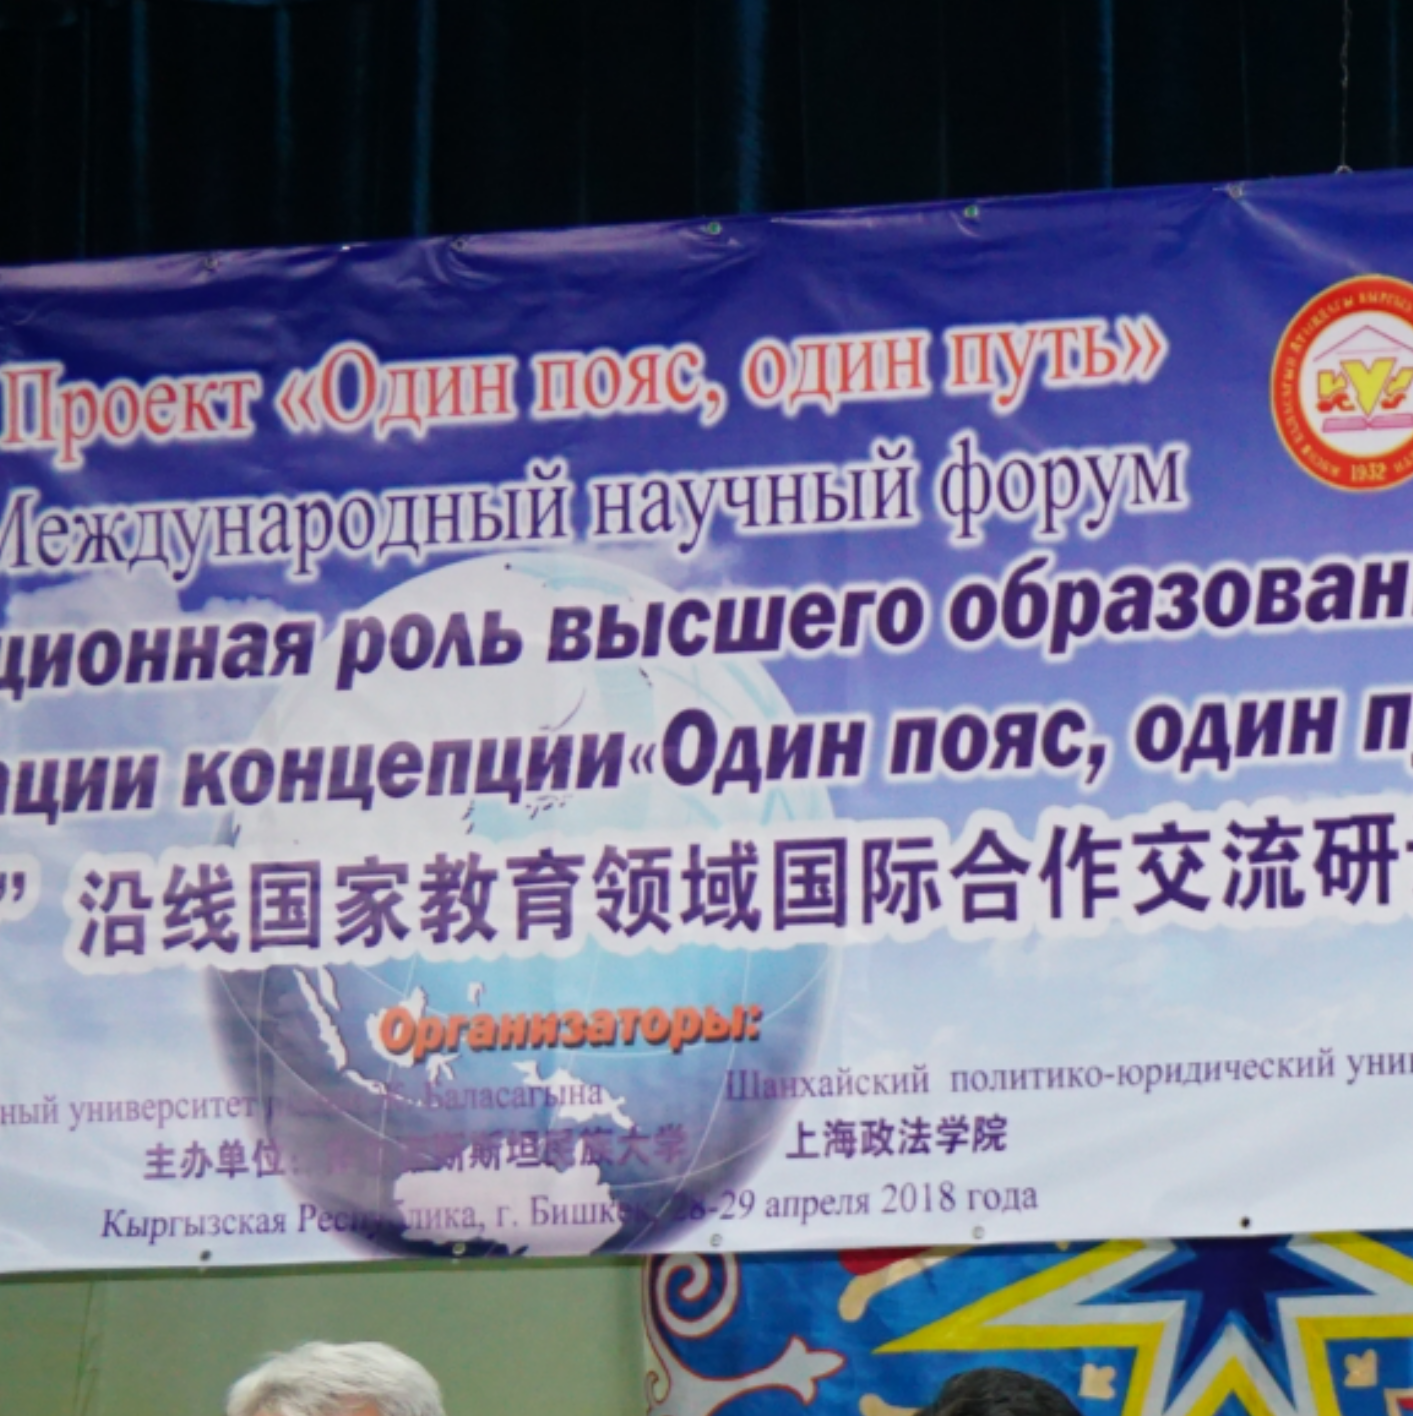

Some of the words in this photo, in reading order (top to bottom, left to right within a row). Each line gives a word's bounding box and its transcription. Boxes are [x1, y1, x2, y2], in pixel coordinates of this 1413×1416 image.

[2, 367, 257, 462] Проект
[278, 346, 512, 437] «Один
[539, 348, 722, 421] пояс,
[749, 337, 925, 411] один
[952, 322, 1163, 406] путь»
[594, 444, 912, 554] научный
[942, 438, 1185, 538] форум
[1351, 461, 1387, 482] 1932
[336, 608, 522, 691] роль
[548, 586, 923, 663] высшего
[0, 754, 159, 825] ции
[891, 707, 1106, 785] пояс,
[1135, 696, 1338, 773] один
[380, 1003, 761, 1059] Организаторы:
[69, 1094, 257, 1131] университет
[727, 1064, 930, 1100] Шанхайский
[951, 1047, 1335, 1093] политико-юридический
[786, 1113, 1008, 1159] 上海政法学院
[101, 1208, 287, 1246] Кыргызская
[298, 1199, 485, 1240] Респлика,
[496, 1206, 518, 1227] г.
[766, 1190, 870, 1225] апреля
[882, 1181, 956, 1215] 2018
[967, 1186, 1038, 1212] года
